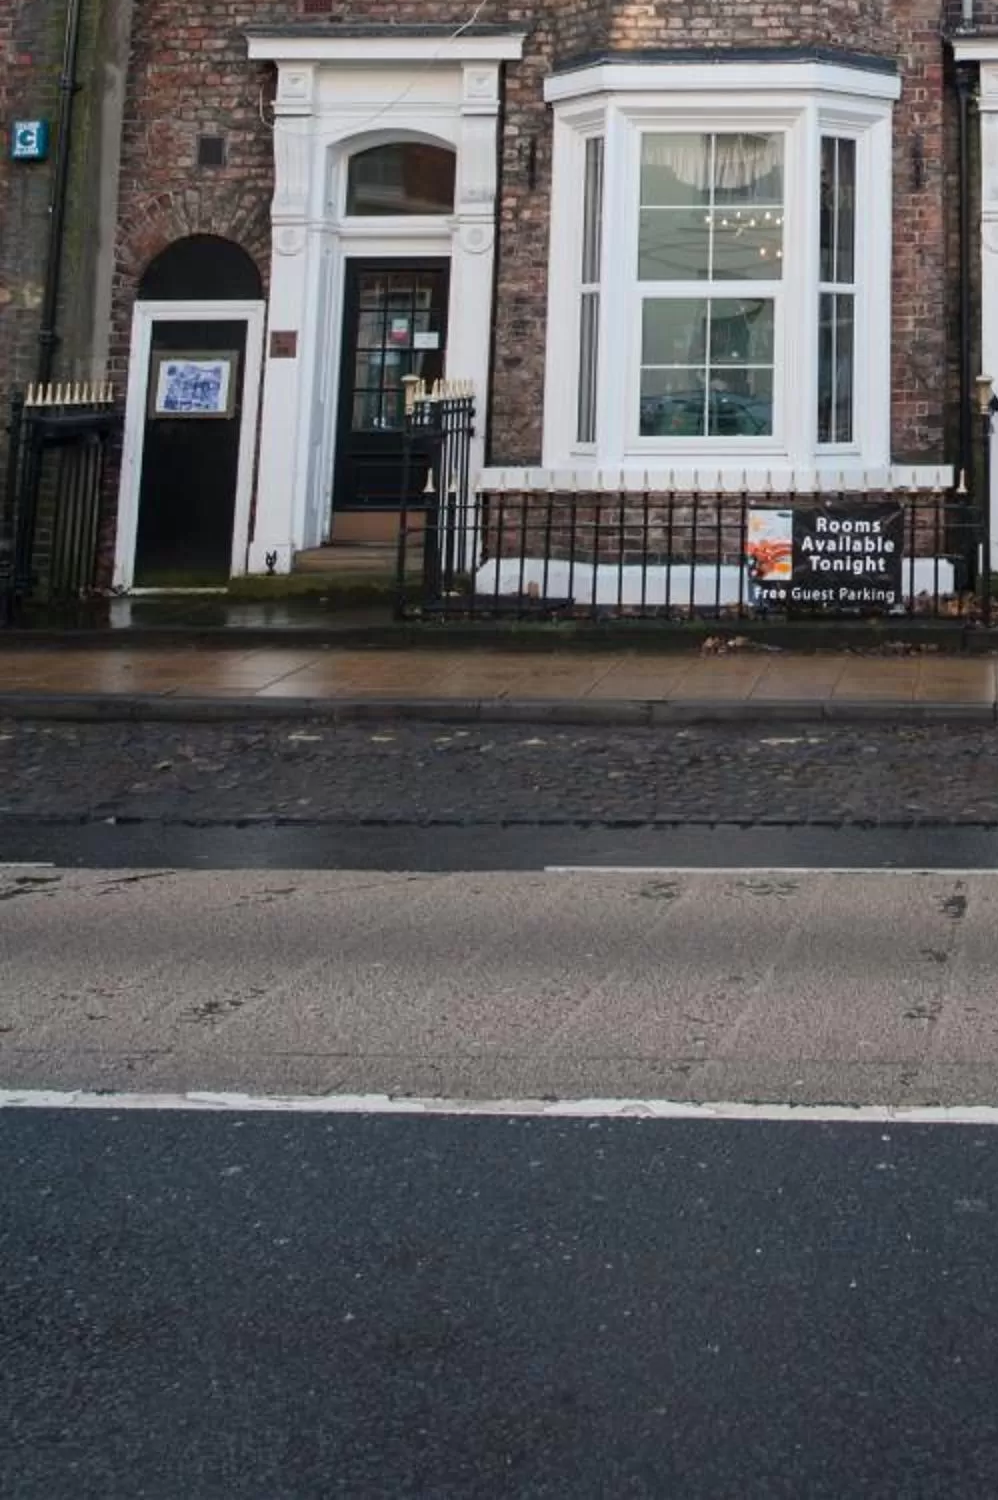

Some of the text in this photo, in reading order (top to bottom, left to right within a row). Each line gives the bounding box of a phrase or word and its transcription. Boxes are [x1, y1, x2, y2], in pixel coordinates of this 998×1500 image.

[816, 517, 881, 533] Rooms
[801, 536, 895, 552] Available
[810, 556, 886, 575] Tonight
[754, 587, 895, 603] Free Guest Parking
